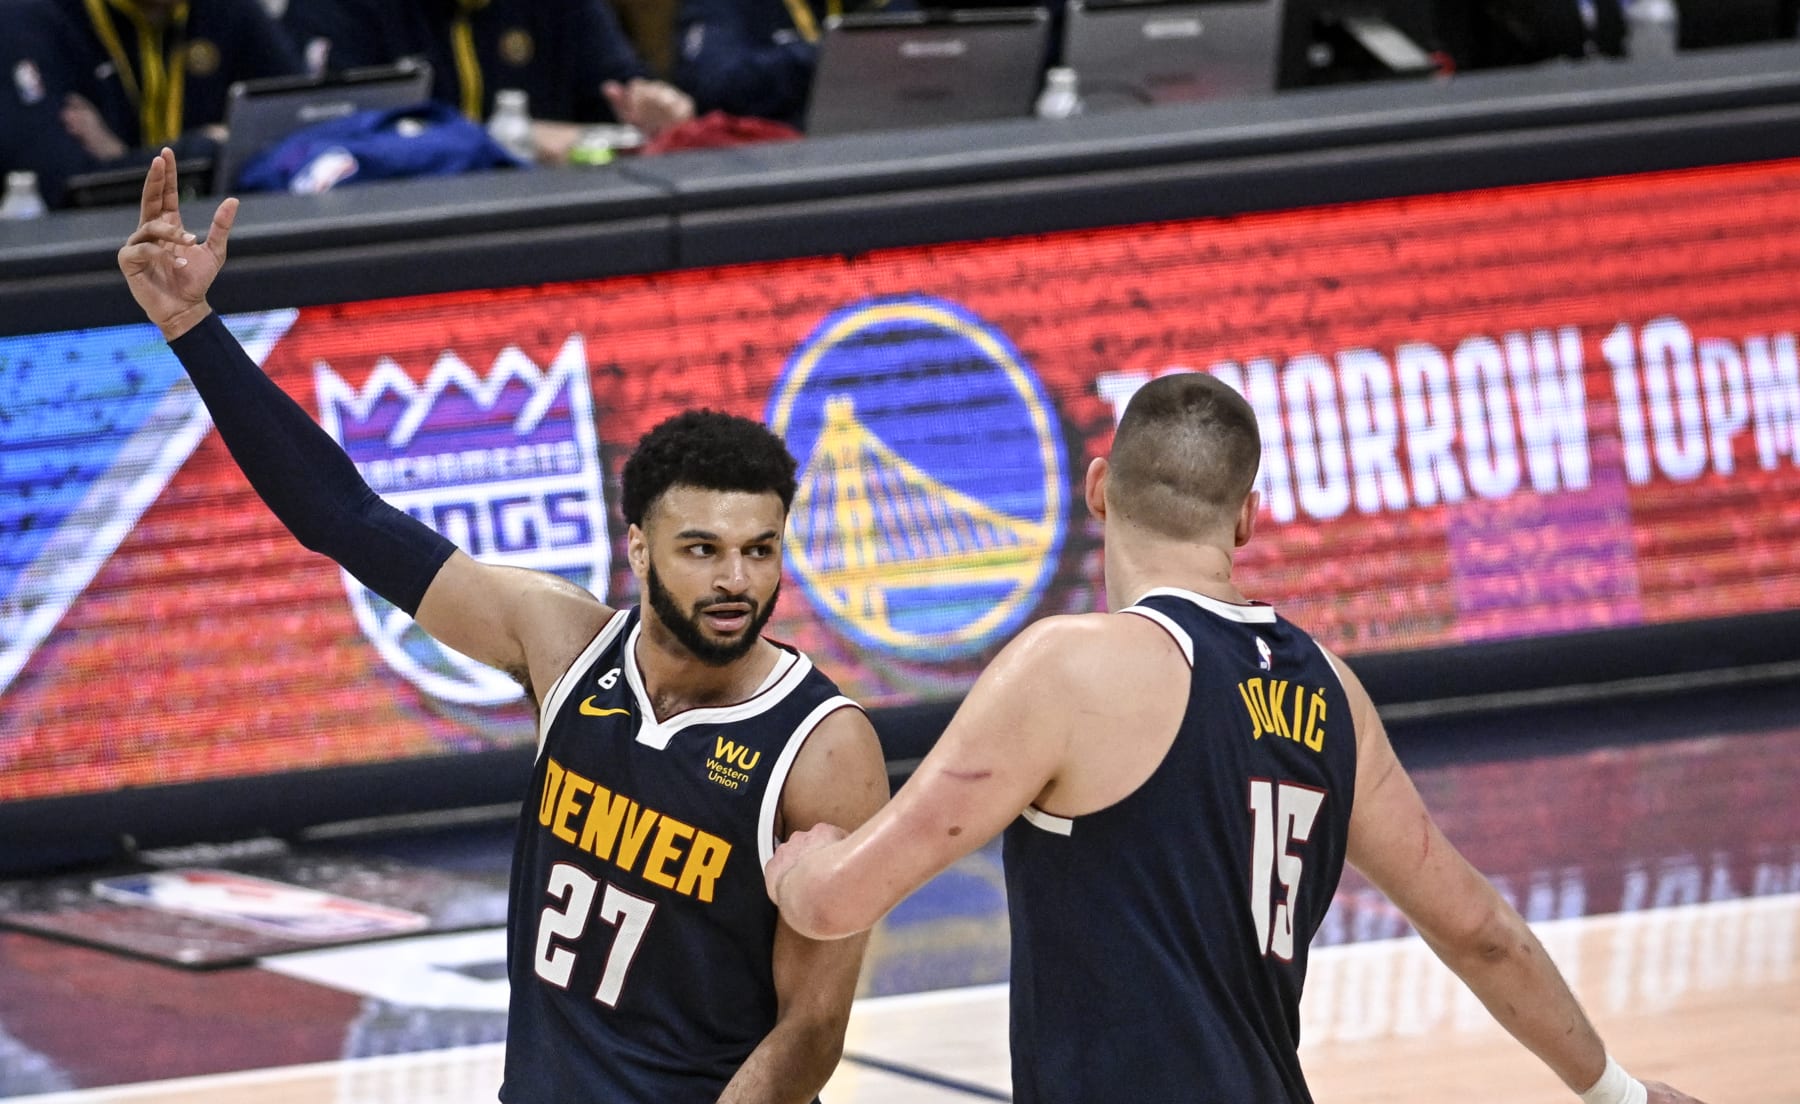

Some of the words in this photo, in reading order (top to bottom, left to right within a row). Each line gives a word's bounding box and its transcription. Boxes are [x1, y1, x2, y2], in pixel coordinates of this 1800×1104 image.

[597, 667, 622, 690] 6
[1238, 677, 1327, 752] JOKIĆ
[706, 758, 749, 783] Western
[708, 770, 738, 790] Union
[714, 735, 761, 770] WU
[538, 755, 733, 903] DENVER
[1248, 777, 1328, 964] 15
[533, 860, 658, 1010] 27
